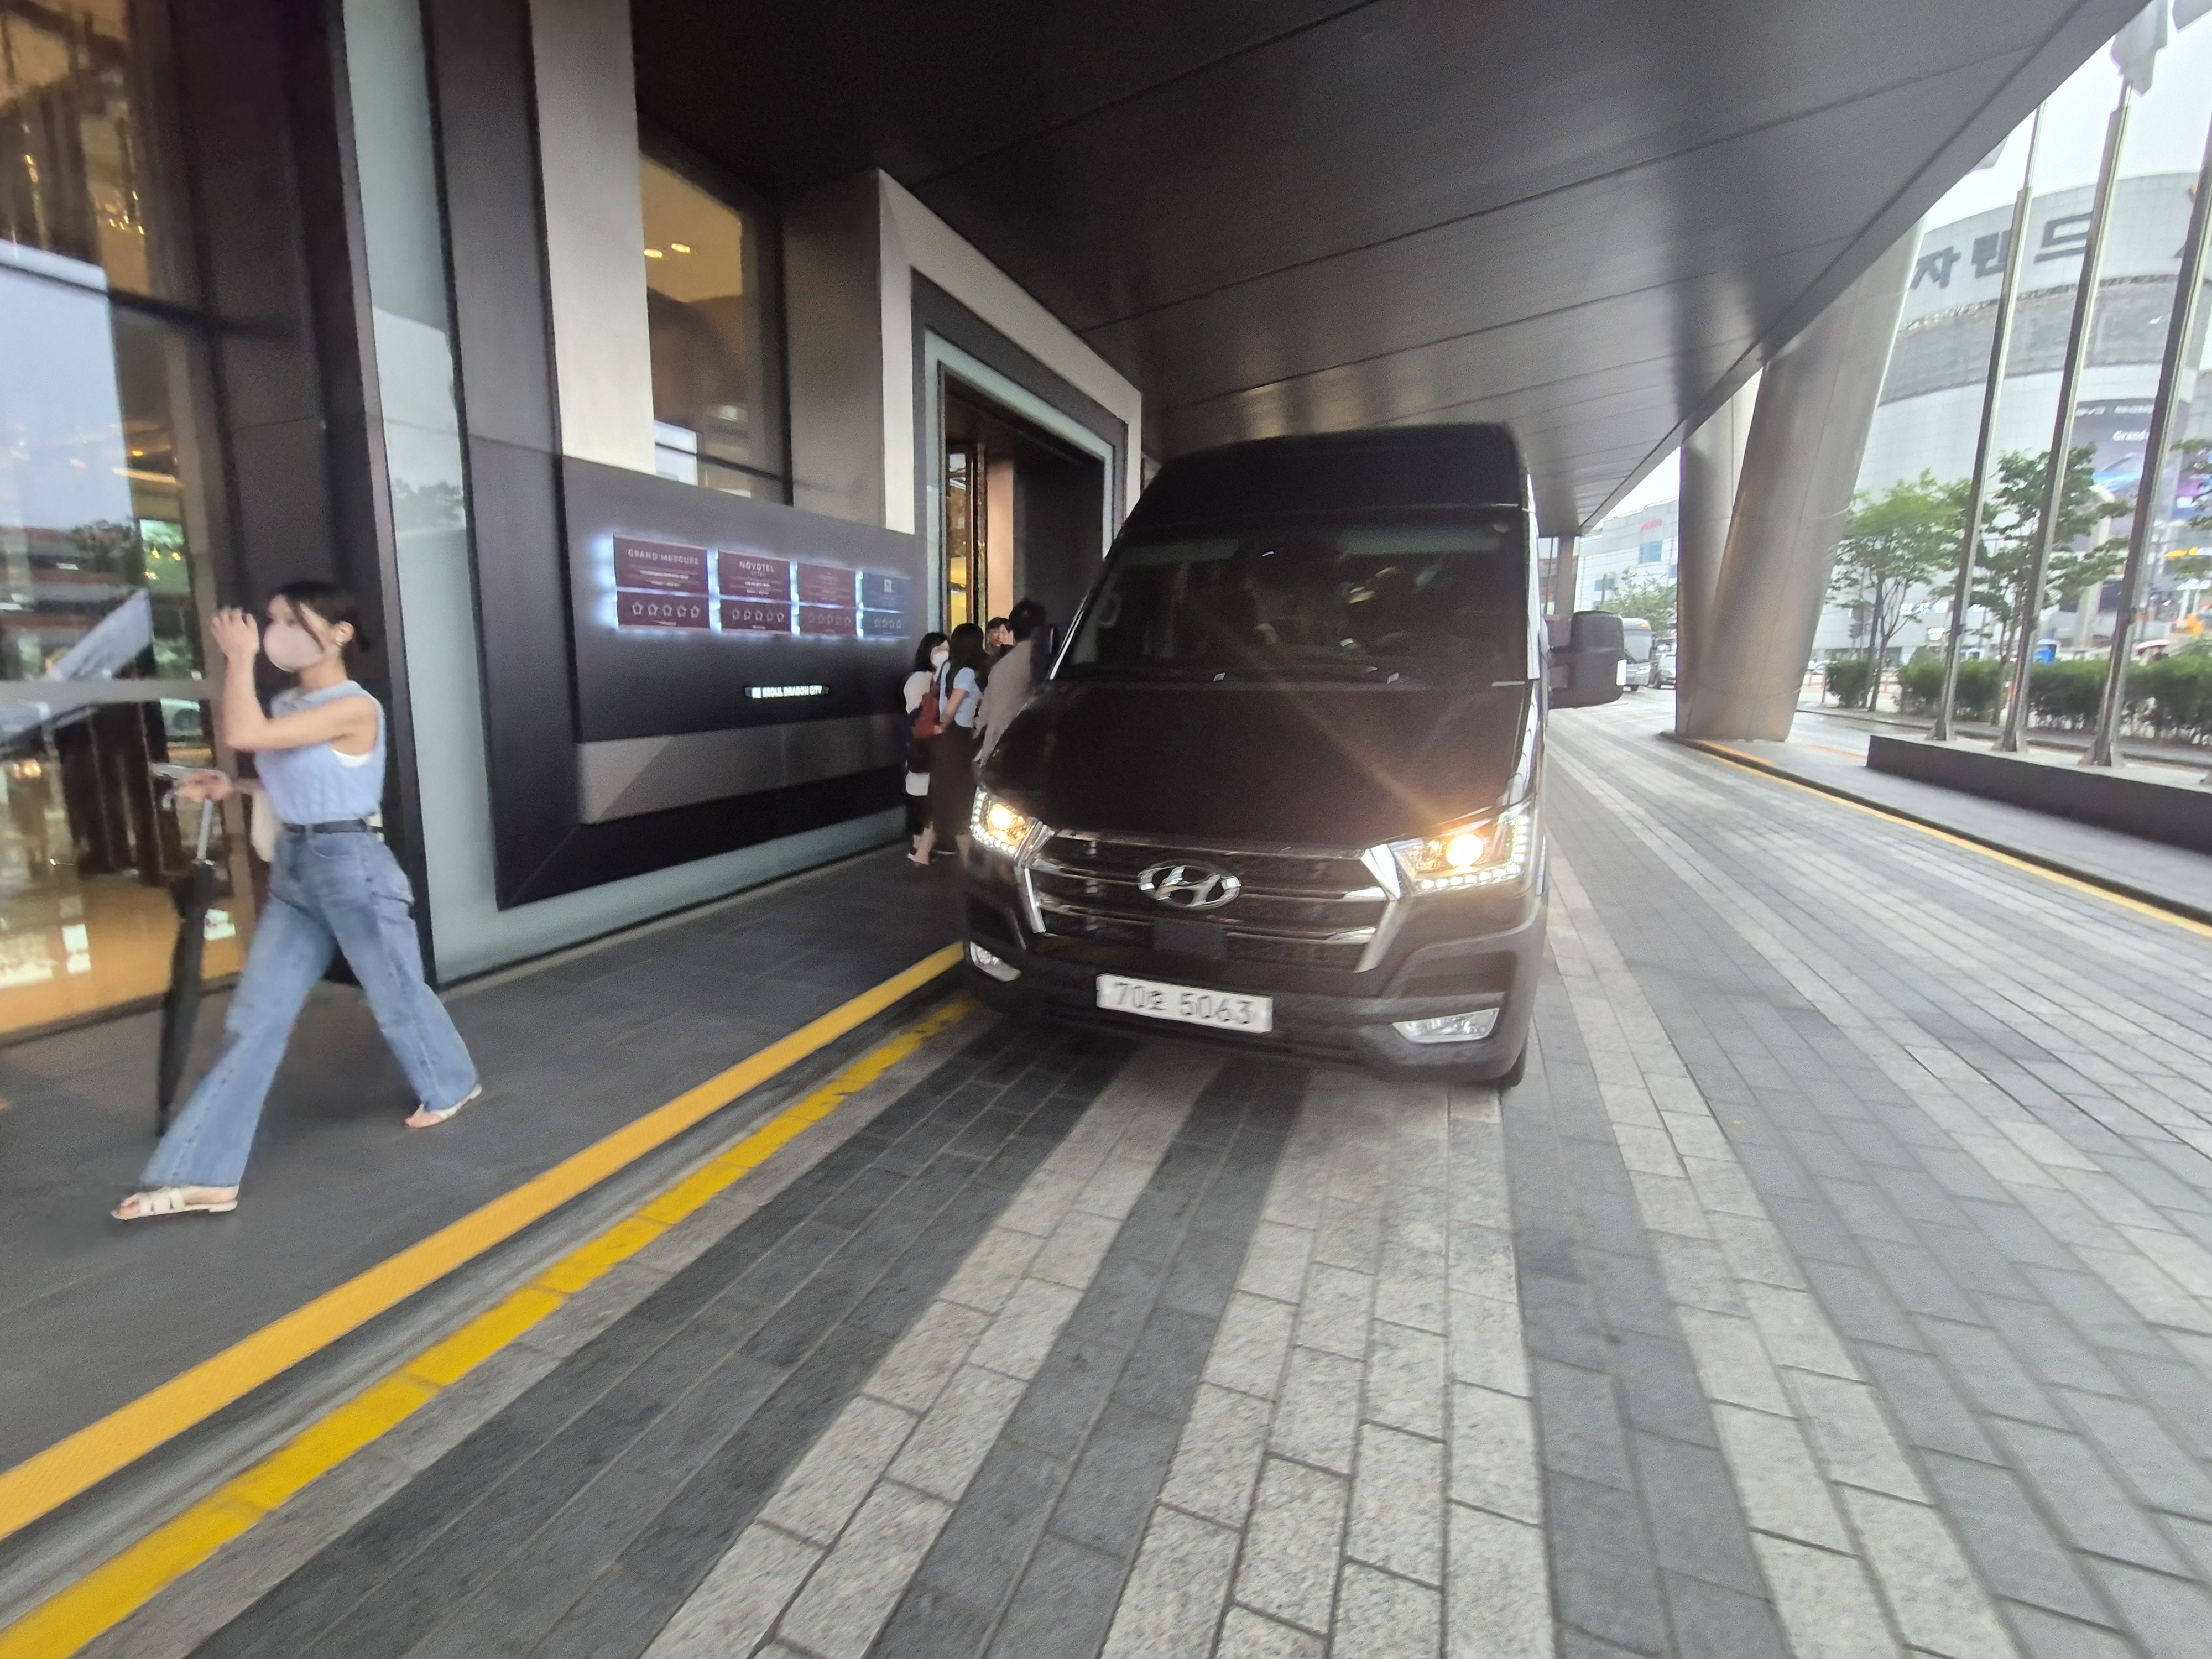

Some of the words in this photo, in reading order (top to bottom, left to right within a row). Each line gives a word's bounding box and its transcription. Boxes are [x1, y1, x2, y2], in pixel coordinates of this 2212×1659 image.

[2112, 429, 2150, 441] Grand
[628, 549, 658, 561] GRAND
[660, 554, 699, 565] MERCURE
[739, 561, 775, 573] NOVOTEL
[762, 686, 784, 698] SEOUL
[783, 685, 810, 697] DRAGON
[809, 685, 822, 695] CITY
[1178, 992, 1254, 1025] 5063
